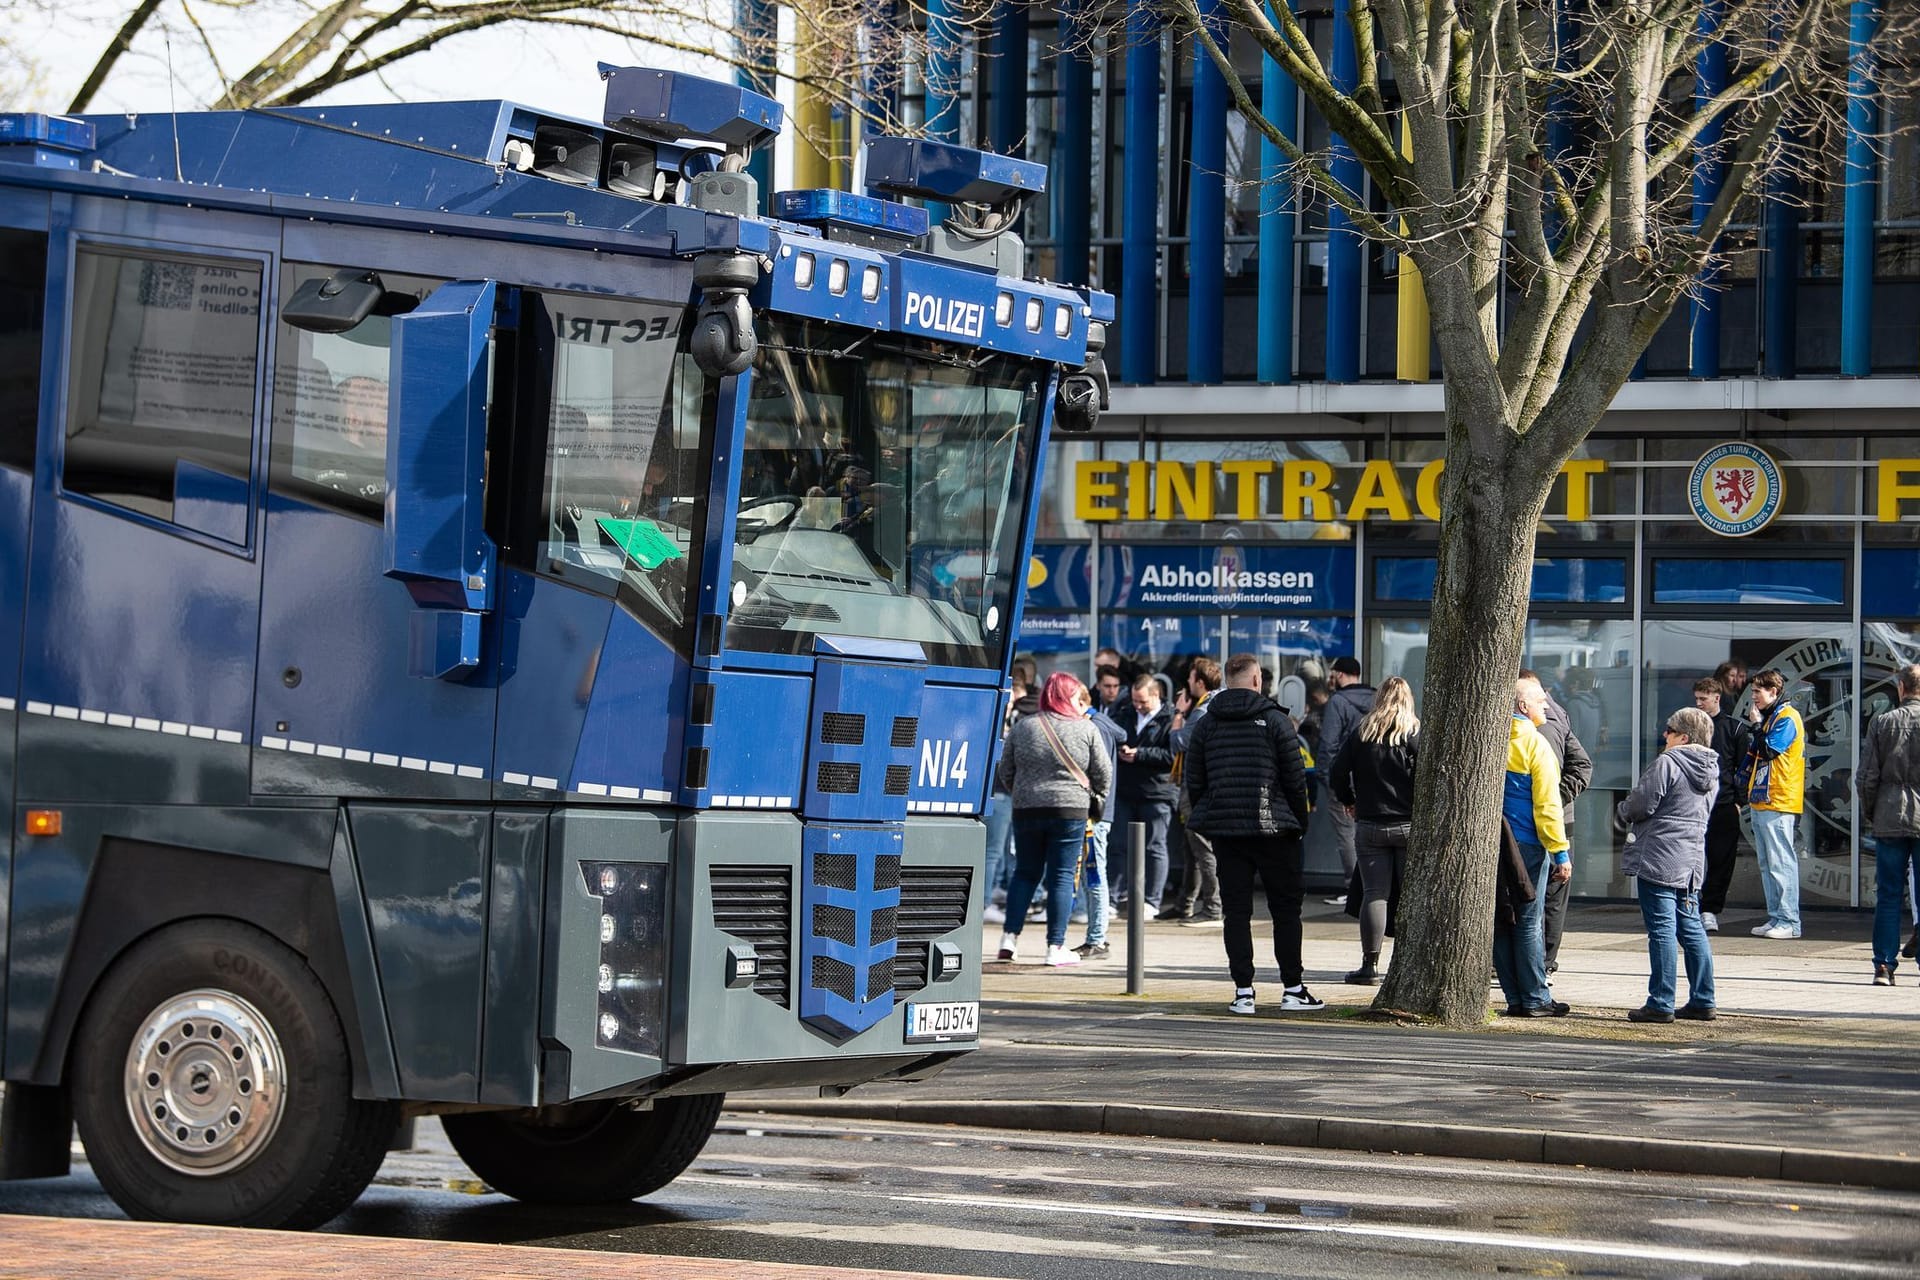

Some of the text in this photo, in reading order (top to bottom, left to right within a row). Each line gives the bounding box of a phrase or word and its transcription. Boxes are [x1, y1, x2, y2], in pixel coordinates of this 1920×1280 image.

[904, 291, 985, 338] POLIZEI
[1692, 447, 1728, 507] BRAUNSCHWEIGER
[1752, 450, 1759, 460] U.
[1758, 456, 1779, 506] SPORTVEREIN
[1074, 459, 1608, 522] EINTRAT
[1701, 512, 1740, 533] EINTRACHT
[1140, 565, 1314, 589] Abholkassen
[1141, 592, 1312, 605] Akkreditierungen/Hinterlegungen
[1141, 618, 1152, 631] A
[1165, 618, 1179, 631] M
[1275, 619, 1287, 632] N
[1299, 619, 1310, 632] Z
[918, 1008, 928, 1032] H
